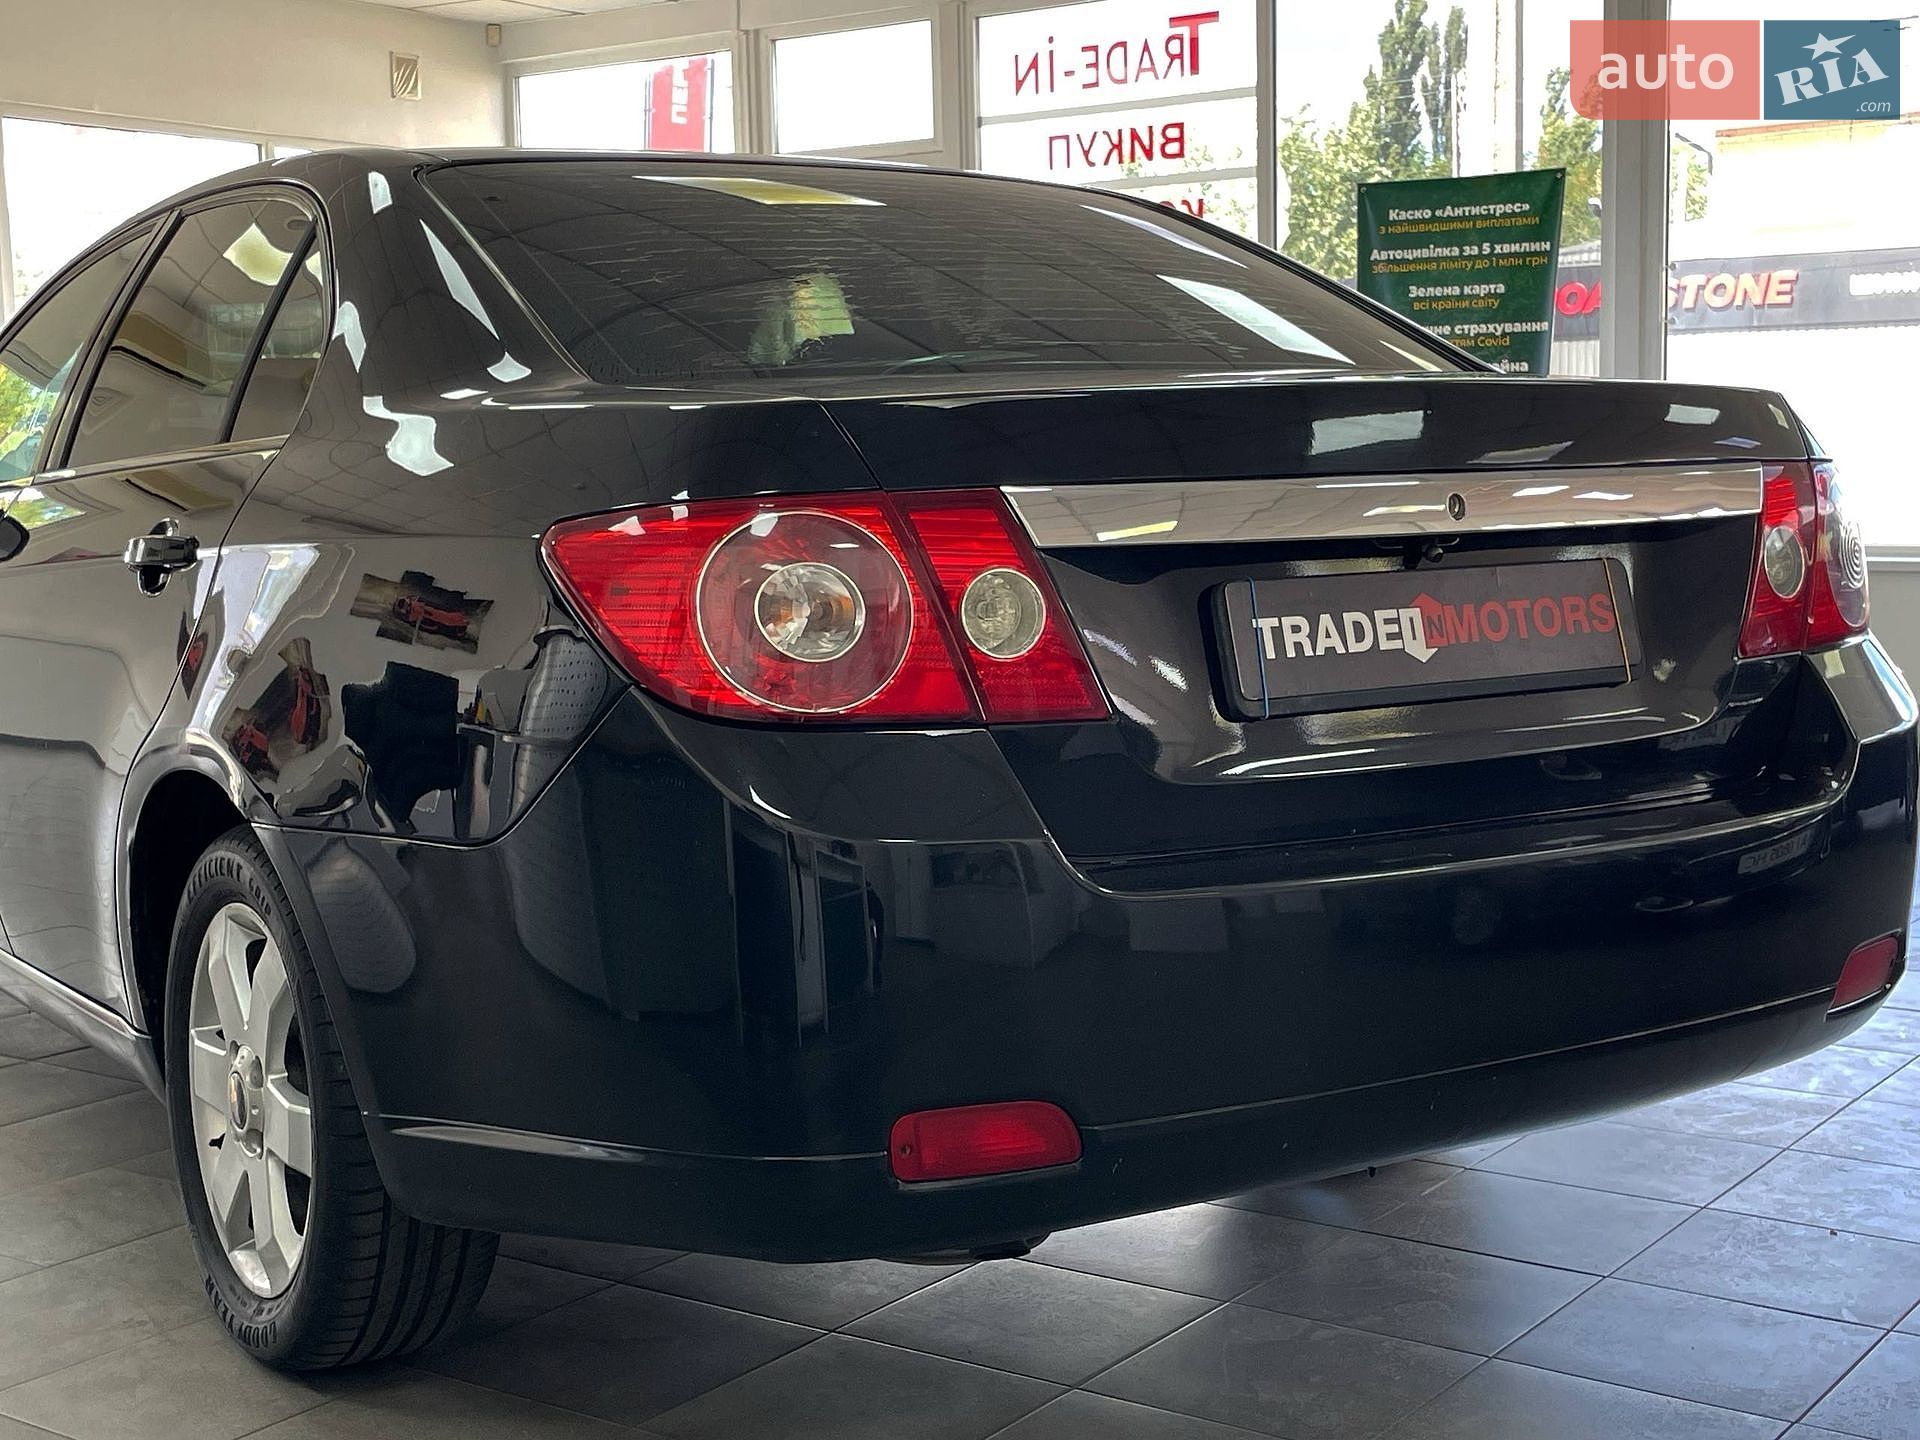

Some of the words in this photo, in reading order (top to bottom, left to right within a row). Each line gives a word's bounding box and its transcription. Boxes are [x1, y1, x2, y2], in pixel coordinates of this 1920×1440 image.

[1388, 208, 1432, 221] Каско
[1434, 202, 1531, 218] «Антистрес»
[1475, 216, 1540, 229] виплатами
[1370, 244, 1460, 261] Автоцивілка
[1462, 245, 1479, 256] за
[1481, 242, 1491, 255] 5
[1493, 241, 1552, 254] хвилин
[1372, 261, 1438, 274] збільшення
[1439, 257, 1474, 271] ліміту
[1474, 259, 1490, 269] до
[1491, 256, 1497, 267] 1
[1498, 256, 1523, 267] млн
[1526, 255, 1548, 268] грн
[1408, 285, 1461, 298] Зелена
[1463, 283, 1505, 297] карта
[1413, 300, 1429, 311] всі
[1471, 297, 1500, 310] світу
[1454, 320, 1549, 336] страхування
[1477, 336, 1510, 347] Covid
[1252, 608, 1402, 660] TRADE
[1445, 593, 1618, 645] MOTORS
